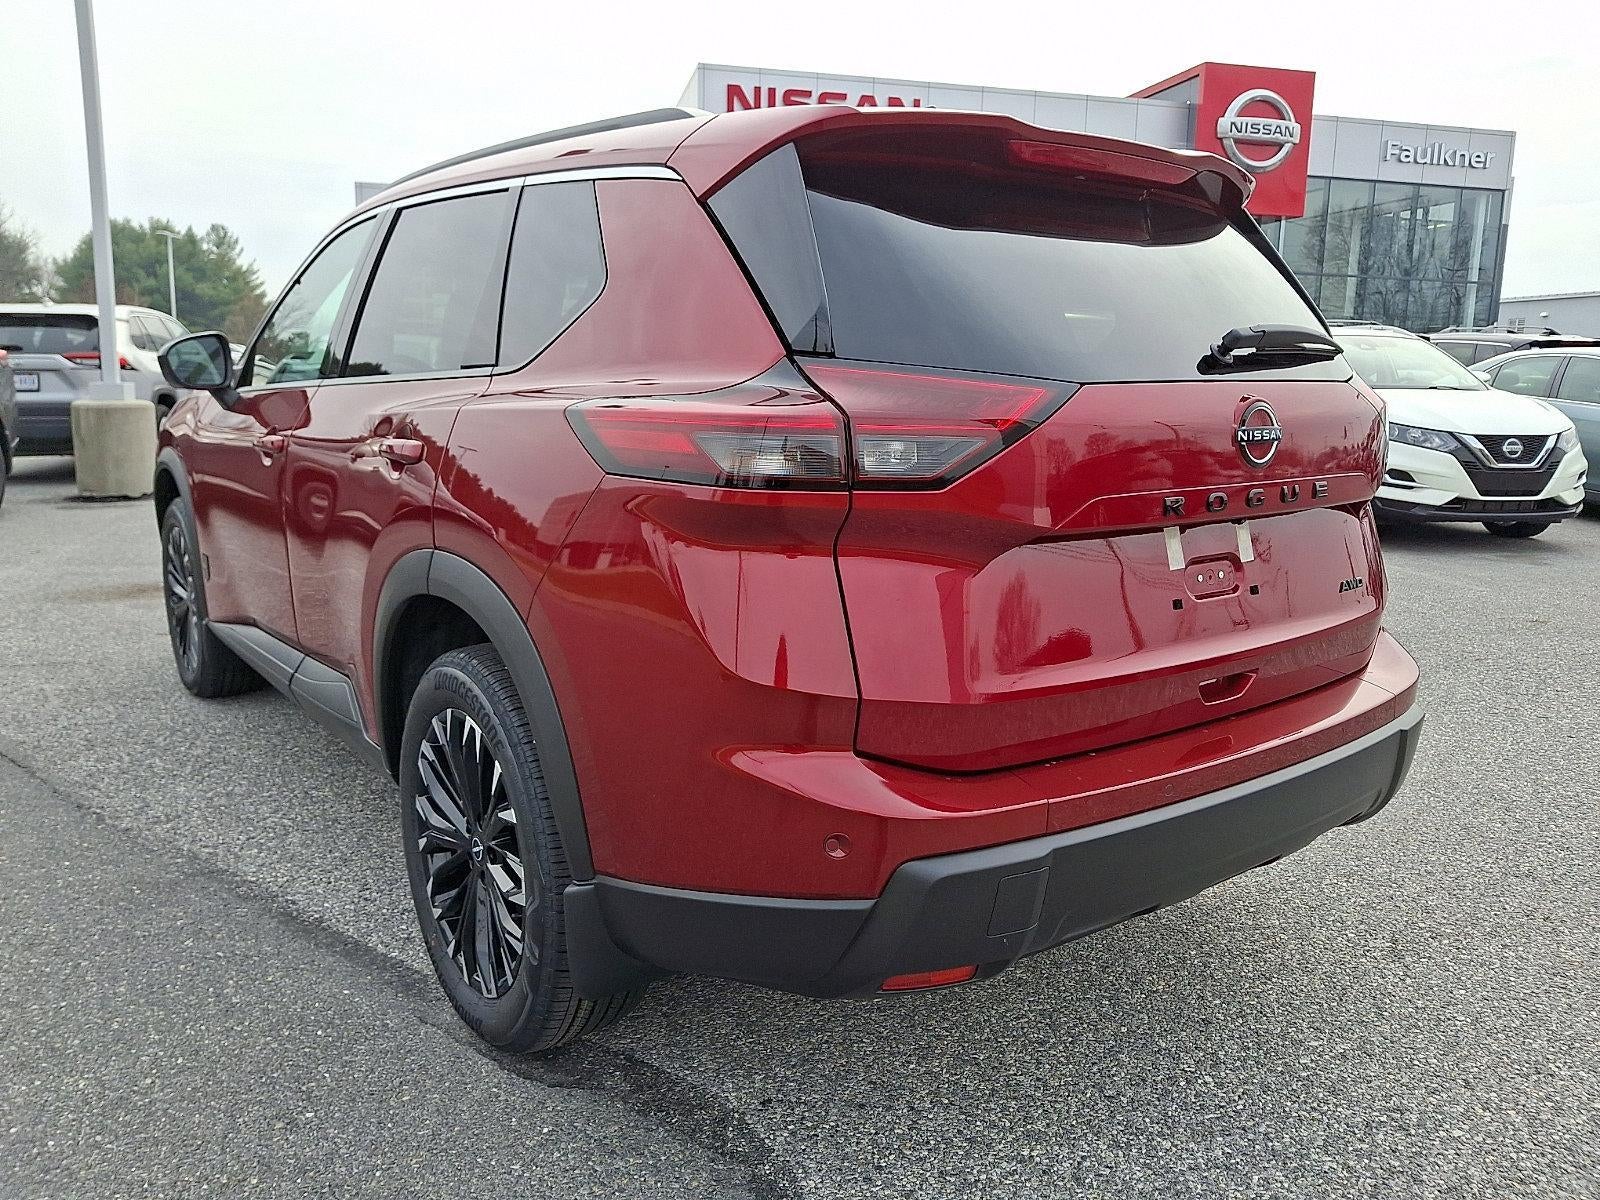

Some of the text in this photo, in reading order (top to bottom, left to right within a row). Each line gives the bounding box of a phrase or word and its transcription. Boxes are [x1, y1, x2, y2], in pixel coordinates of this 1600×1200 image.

[1229, 120, 1295, 139] NISSAN
[1384, 139, 1495, 168] Faulkner
[1237, 427, 1283, 442] NISSAN
[1164, 480, 1328, 517] ROGUE
[1338, 577, 1364, 593] AWD
